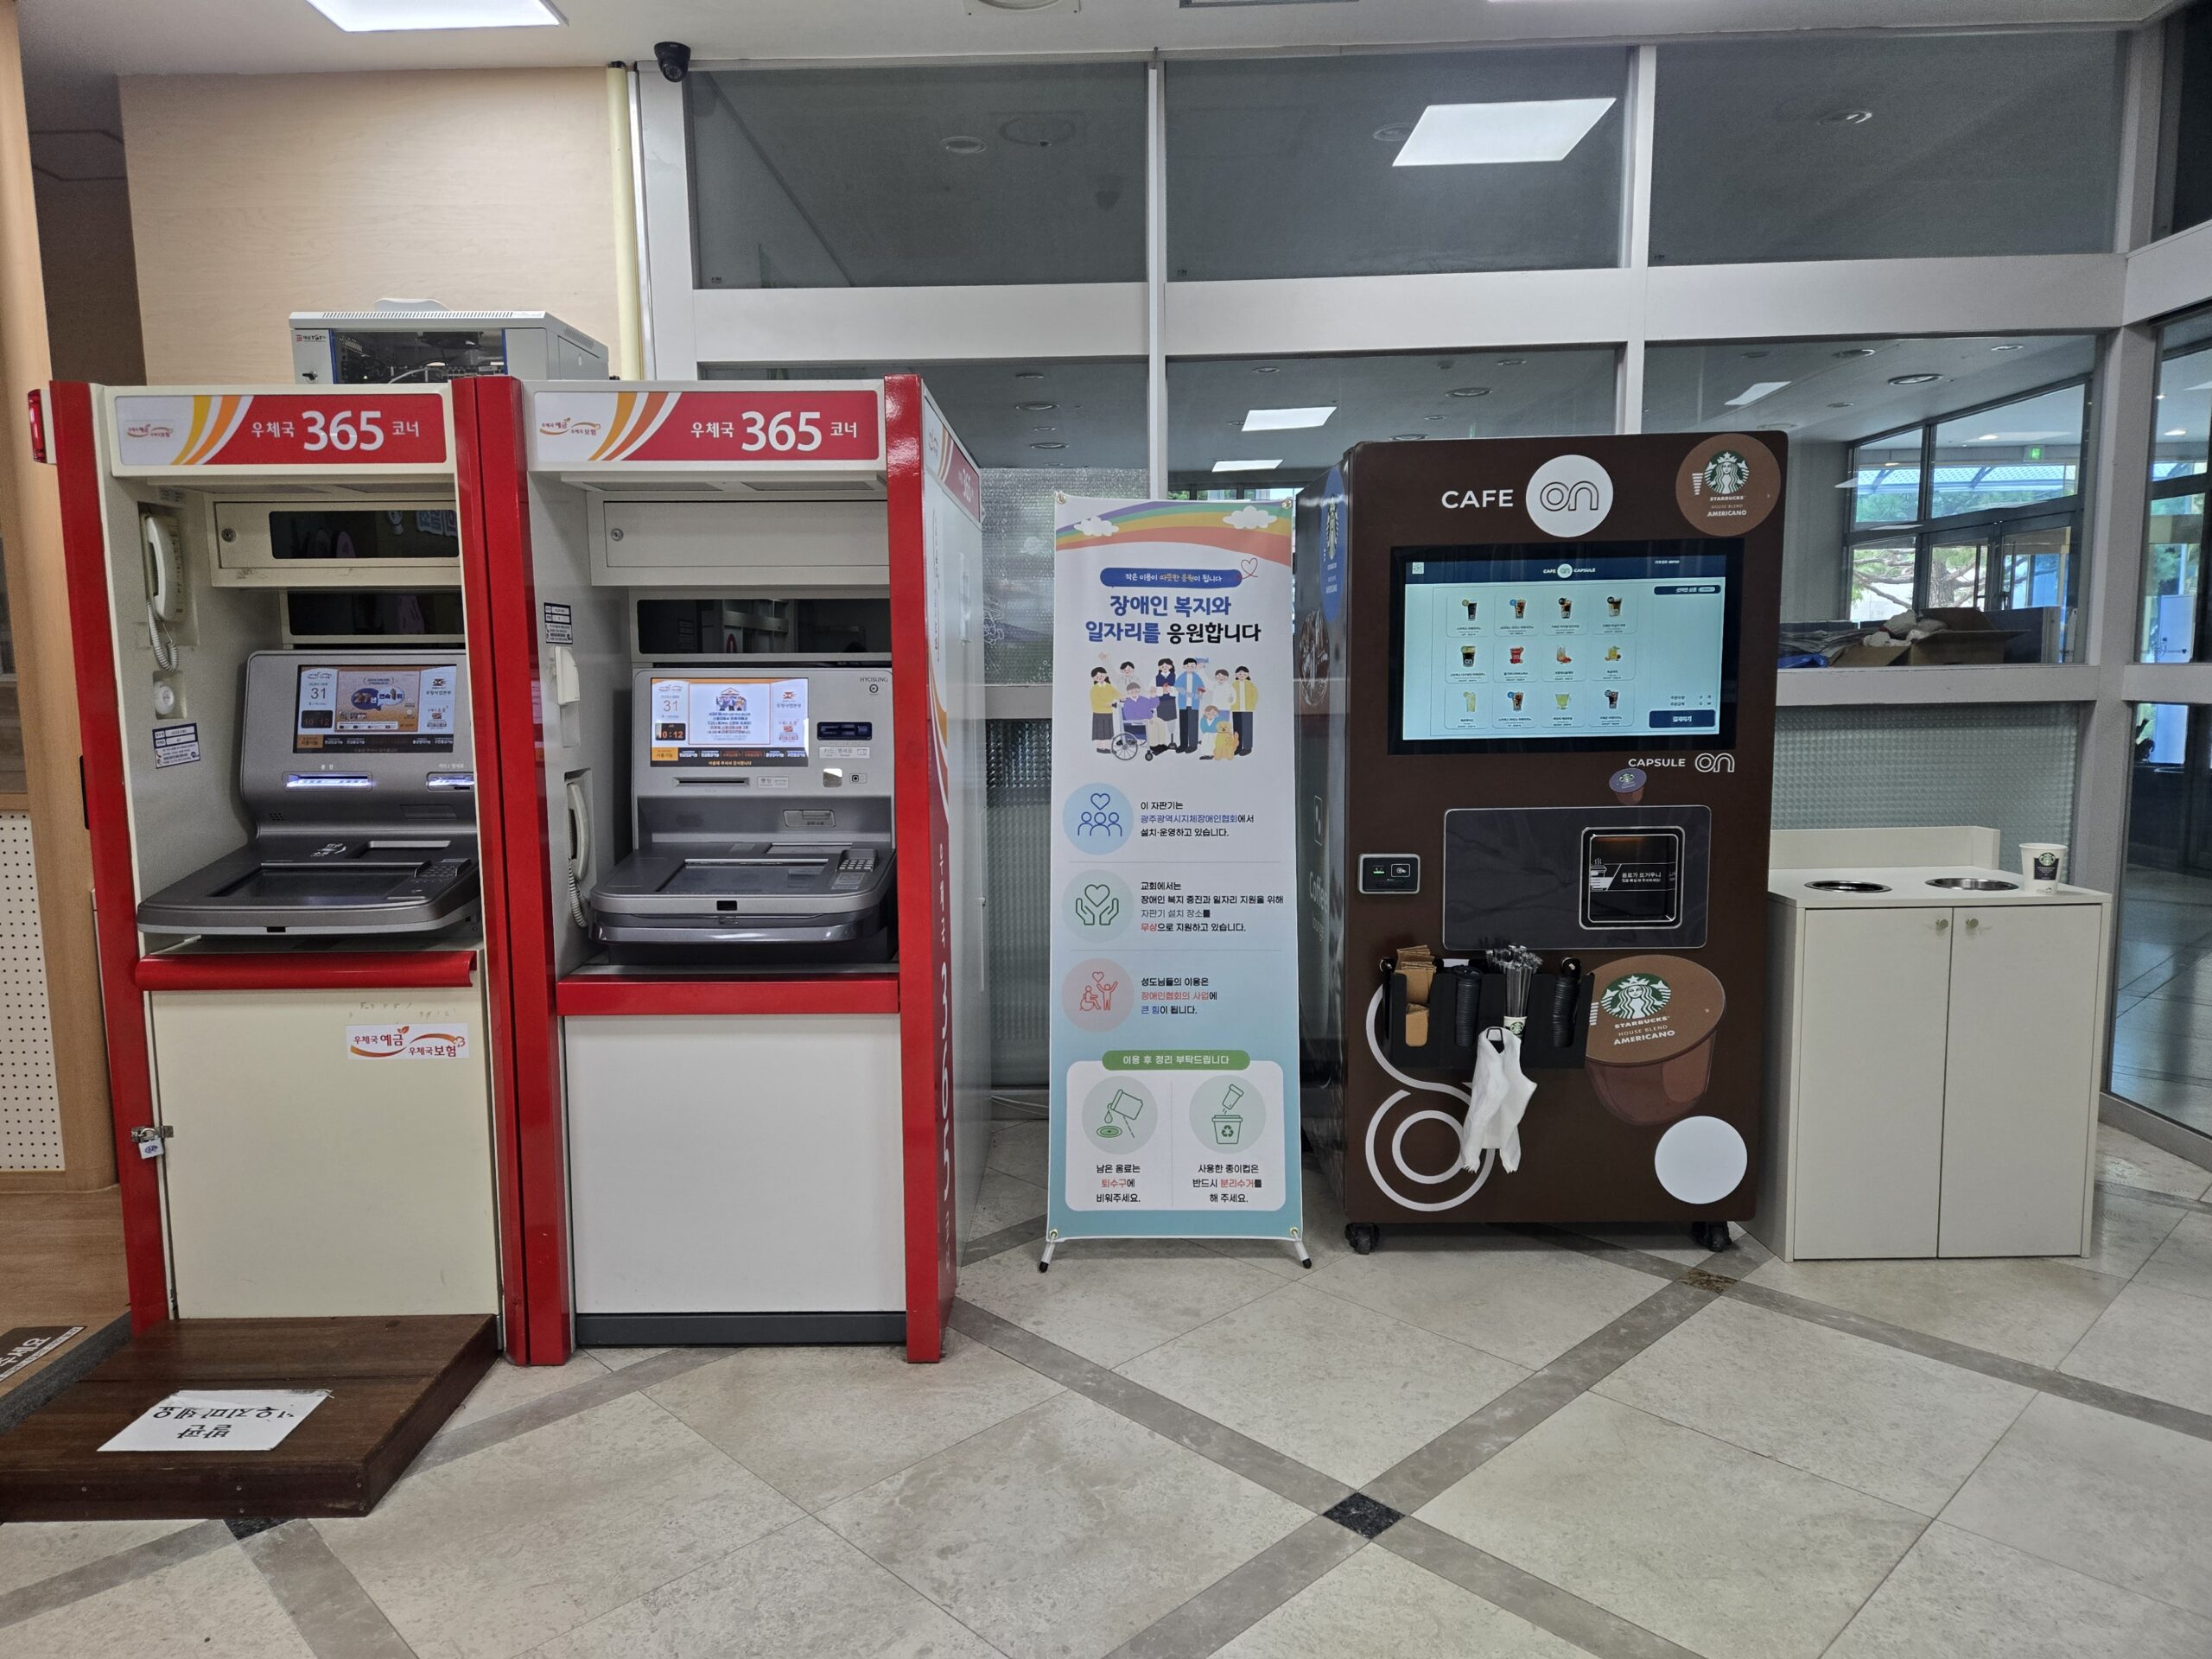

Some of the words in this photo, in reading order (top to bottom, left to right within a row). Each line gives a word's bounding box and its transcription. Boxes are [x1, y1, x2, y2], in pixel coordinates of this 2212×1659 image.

[251, 422, 295, 438] 우체국
[302, 410, 384, 451] 365
[392, 422, 419, 437] 코너
[690, 423, 734, 438] 우체국
[741, 411, 822, 451] 365
[830, 422, 857, 438] 코너
[1441, 489, 1513, 509] CAFE
[1202, 574, 1222, 582] 됩니다
[1110, 595, 1167, 616] 장애인
[1174, 596, 1231, 617] 복지와
[1085, 621, 1160, 643] 일자리를
[1166, 622, 1262, 645] 응원합니다
[310, 688, 326, 700] 31
[663, 700, 678, 712] 31
[1628, 759, 1686, 767] CAPSULE
[1141, 801, 1148, 810] 이
[1151, 801, 1184, 810] 자판기는
[1141, 814, 1254, 824] 광주광역시지체장애인협회에서
[1194, 828, 1229, 837] 있습니다.
[1141, 881, 1181, 891] 교회에서는
[1141, 895, 1165, 905] 장애인
[1167, 895, 1184, 905] 복지
[1186, 895, 1211, 905] 증진과
[1213, 895, 1237, 905] 일자리
[1240, 895, 1264, 905] 지원을
[1267, 895, 1283, 905] 위해
[1141, 909, 1166, 918] 자판기
[1167, 909, 1184, 918] 설치
[1141, 923, 1173, 932] 무상으로
[1176, 923, 1209, 932] 지원하고
[1211, 923, 1246, 932] 있습니다.
[1141, 977, 1182, 987] 성도님들의
[1185, 977, 1209, 987] 이용은
[1141, 991, 1191, 1001] 장애인협회의
[1193, 991, 1217, 1001] 사업에
[1141, 1005, 1149, 1015] 큰
[1152, 1005, 1168, 1015] 힘이
[1170, 1005, 1198, 1015] 됩니다.
[1614, 1016, 1668, 1028] STARBUCKS
[380, 1034, 403, 1046] 예금
[1614, 1030, 1675, 1046] AMERICANO
[435, 1046, 456, 1057] 보험
[1123, 1055, 1140, 1065] 이용
[1143, 1055, 1153, 1065] 후
[1155, 1055, 1173, 1065] 정리
[1176, 1055, 1230, 1065] 부탁드립니다
[941, 961, 950, 1202] 365
[1096, 1164, 1113, 1173] 남은
[1116, 1164, 1141, 1173] 음료는
[1198, 1164, 1224, 1173] 사용한
[1225, 1164, 1259, 1173] 종이컵은
[1101, 1179, 1135, 1188] 퇴수구에
[1192, 1179, 1217, 1188] 반드시
[1220, 1179, 1262, 1188] 분리수거를
[1096, 1193, 1141, 1204] 비워주세요.
[1210, 1193, 1218, 1203] 해
[1221, 1193, 1249, 1204] 주세요.
[177, 1425, 232, 1439] 발판
